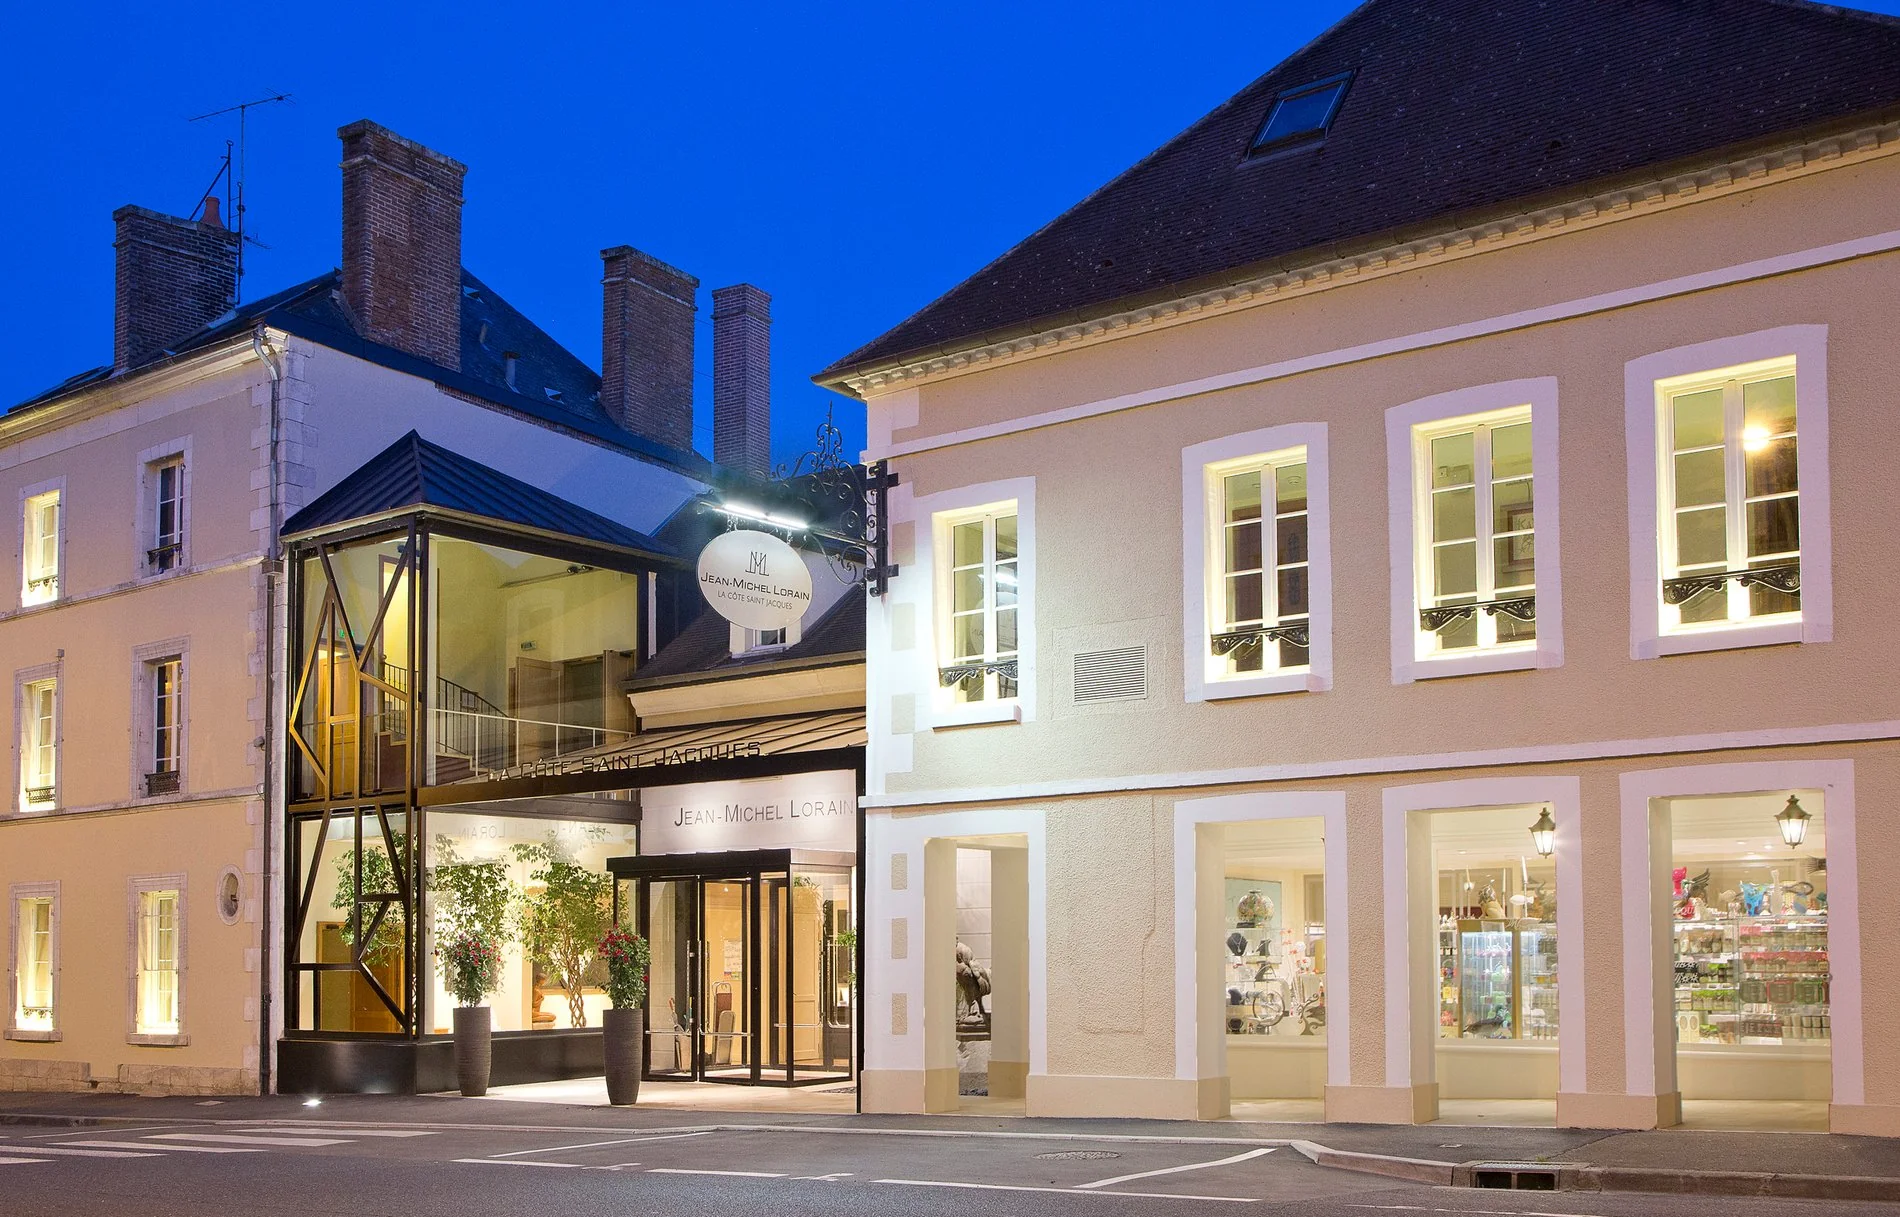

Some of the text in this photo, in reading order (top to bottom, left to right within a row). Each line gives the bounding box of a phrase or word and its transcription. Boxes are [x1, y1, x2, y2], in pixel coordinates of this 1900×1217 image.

[700, 572, 810, 601] JEAN-MICHEL LORAIN
[717, 590, 793, 610] LA CÔTE SAINT JACQUES
[582, 754, 644, 774] SAINT
[655, 741, 760, 767] JACQUES
[674, 800, 854, 827] JEAN-MICHEL LORAIN
